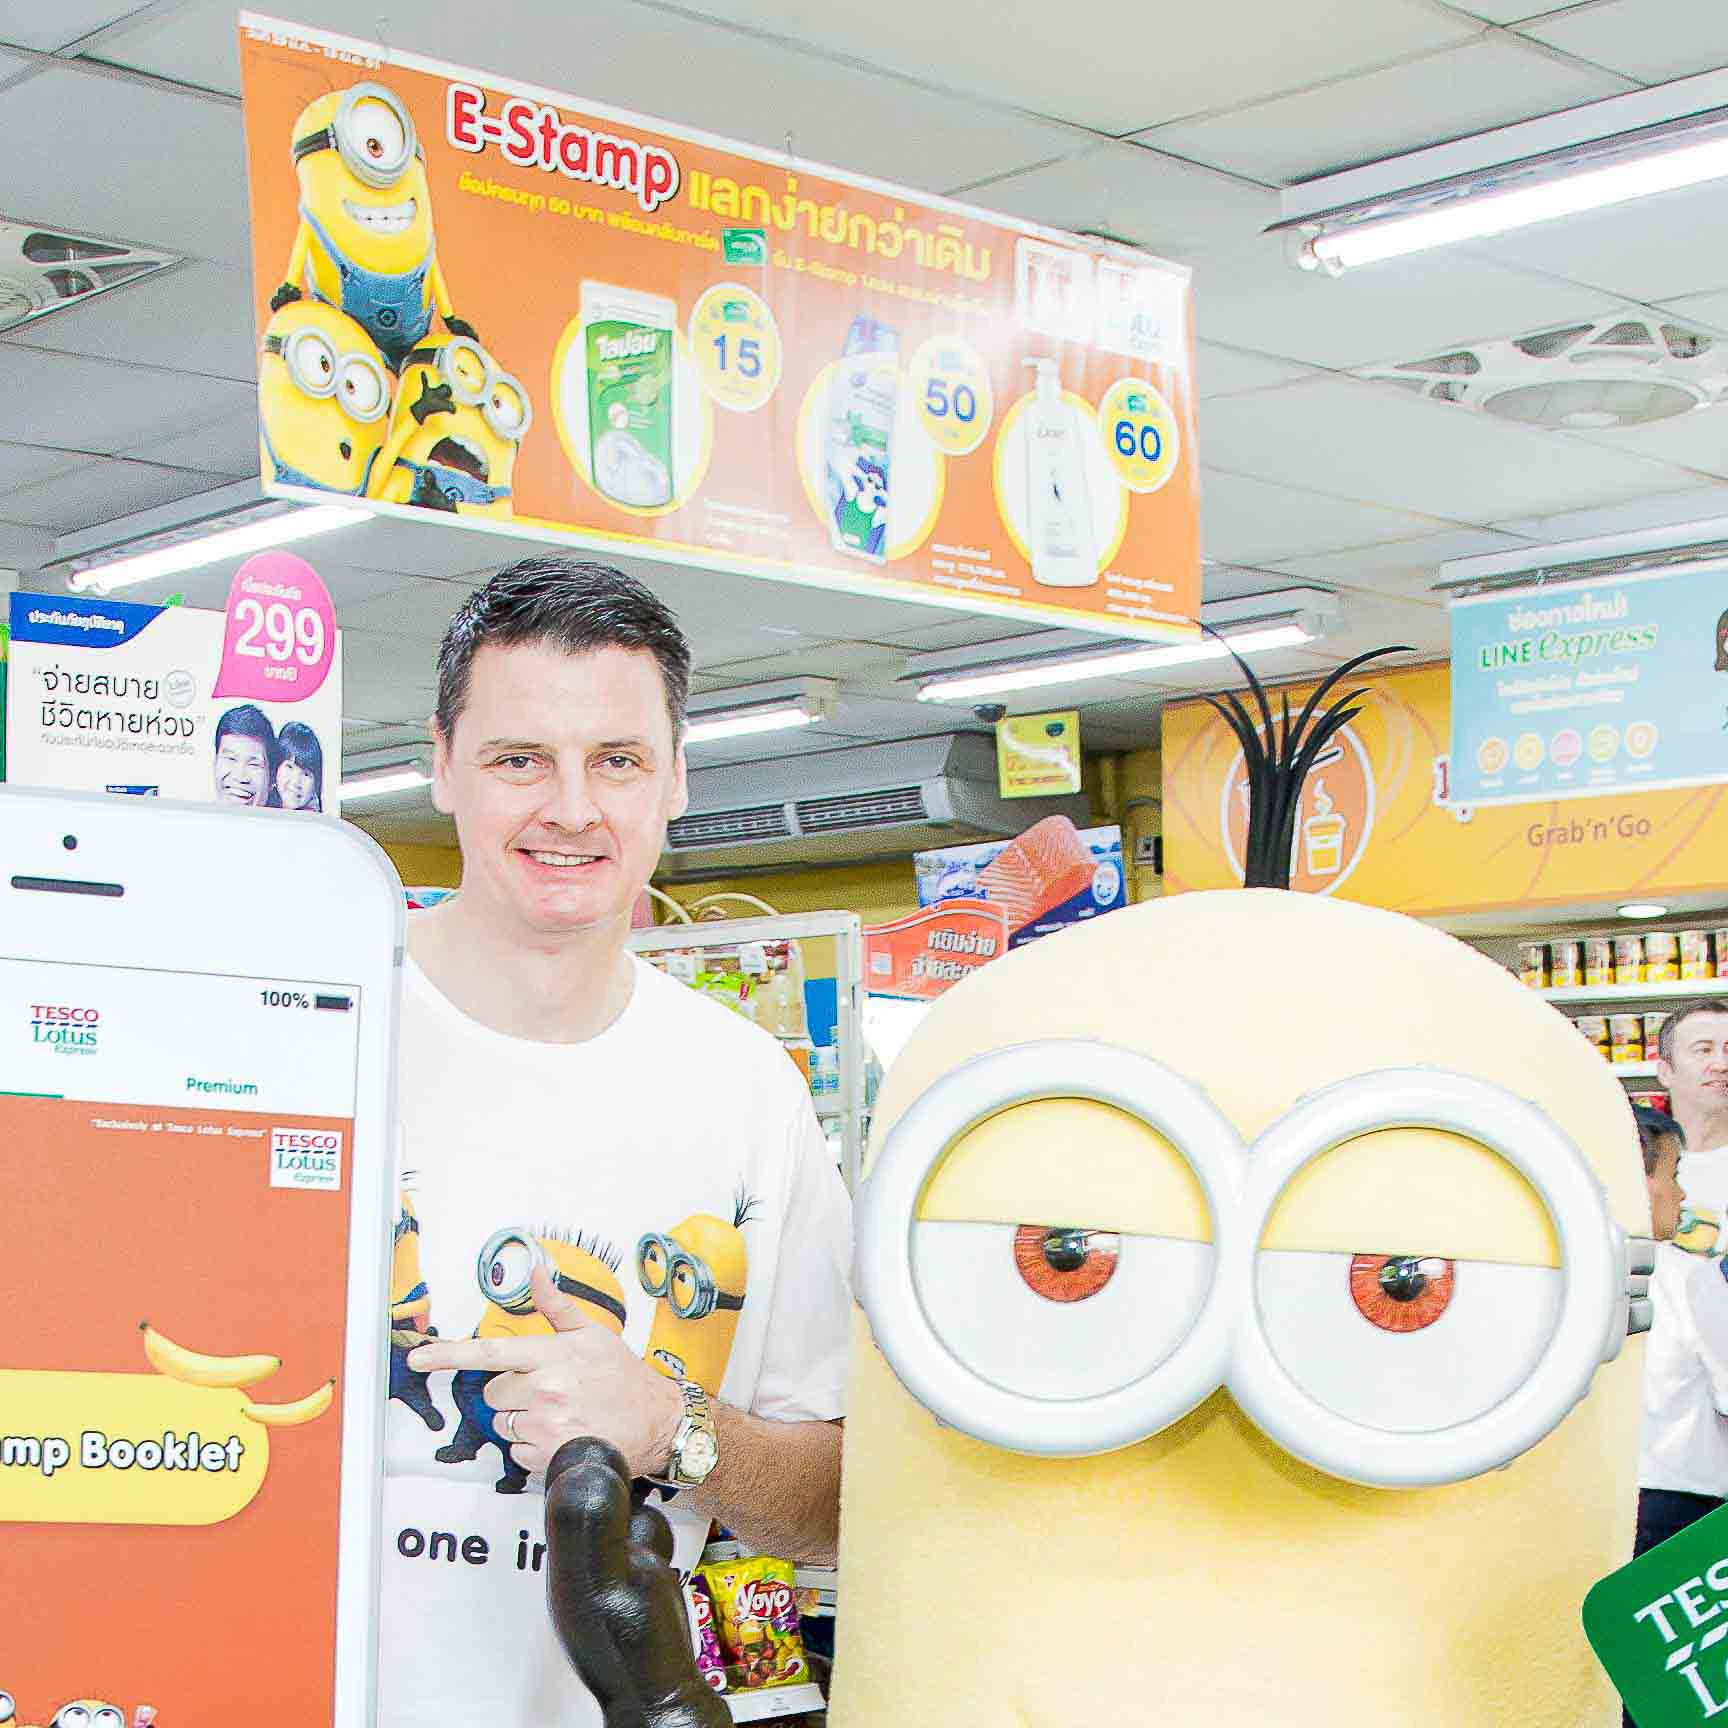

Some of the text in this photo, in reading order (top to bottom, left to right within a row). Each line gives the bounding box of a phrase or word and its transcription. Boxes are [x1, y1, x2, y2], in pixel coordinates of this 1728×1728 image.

[450, 85, 676, 208] E-Stamp
[689, 170, 991, 282] แลกง่ายกว่าเดิม
[713, 335, 761, 379] 15
[926, 378, 976, 422] 50
[1114, 421, 1161, 462] 60
[235, 601, 325, 666] 299
[1482, 623, 1659, 669] LINE Express
[31, 1004, 99, 1024] TESCO
[258, 989, 310, 1010] 100%
[31, 1025, 98, 1047] Lotus
[186, 1076, 259, 1096] Premium
[274, 1133, 338, 1150] TESCO
[276, 1151, 336, 1172] Lotus
[80, 1430, 245, 1475] Booklet
[397, 1525, 491, 1567] one
